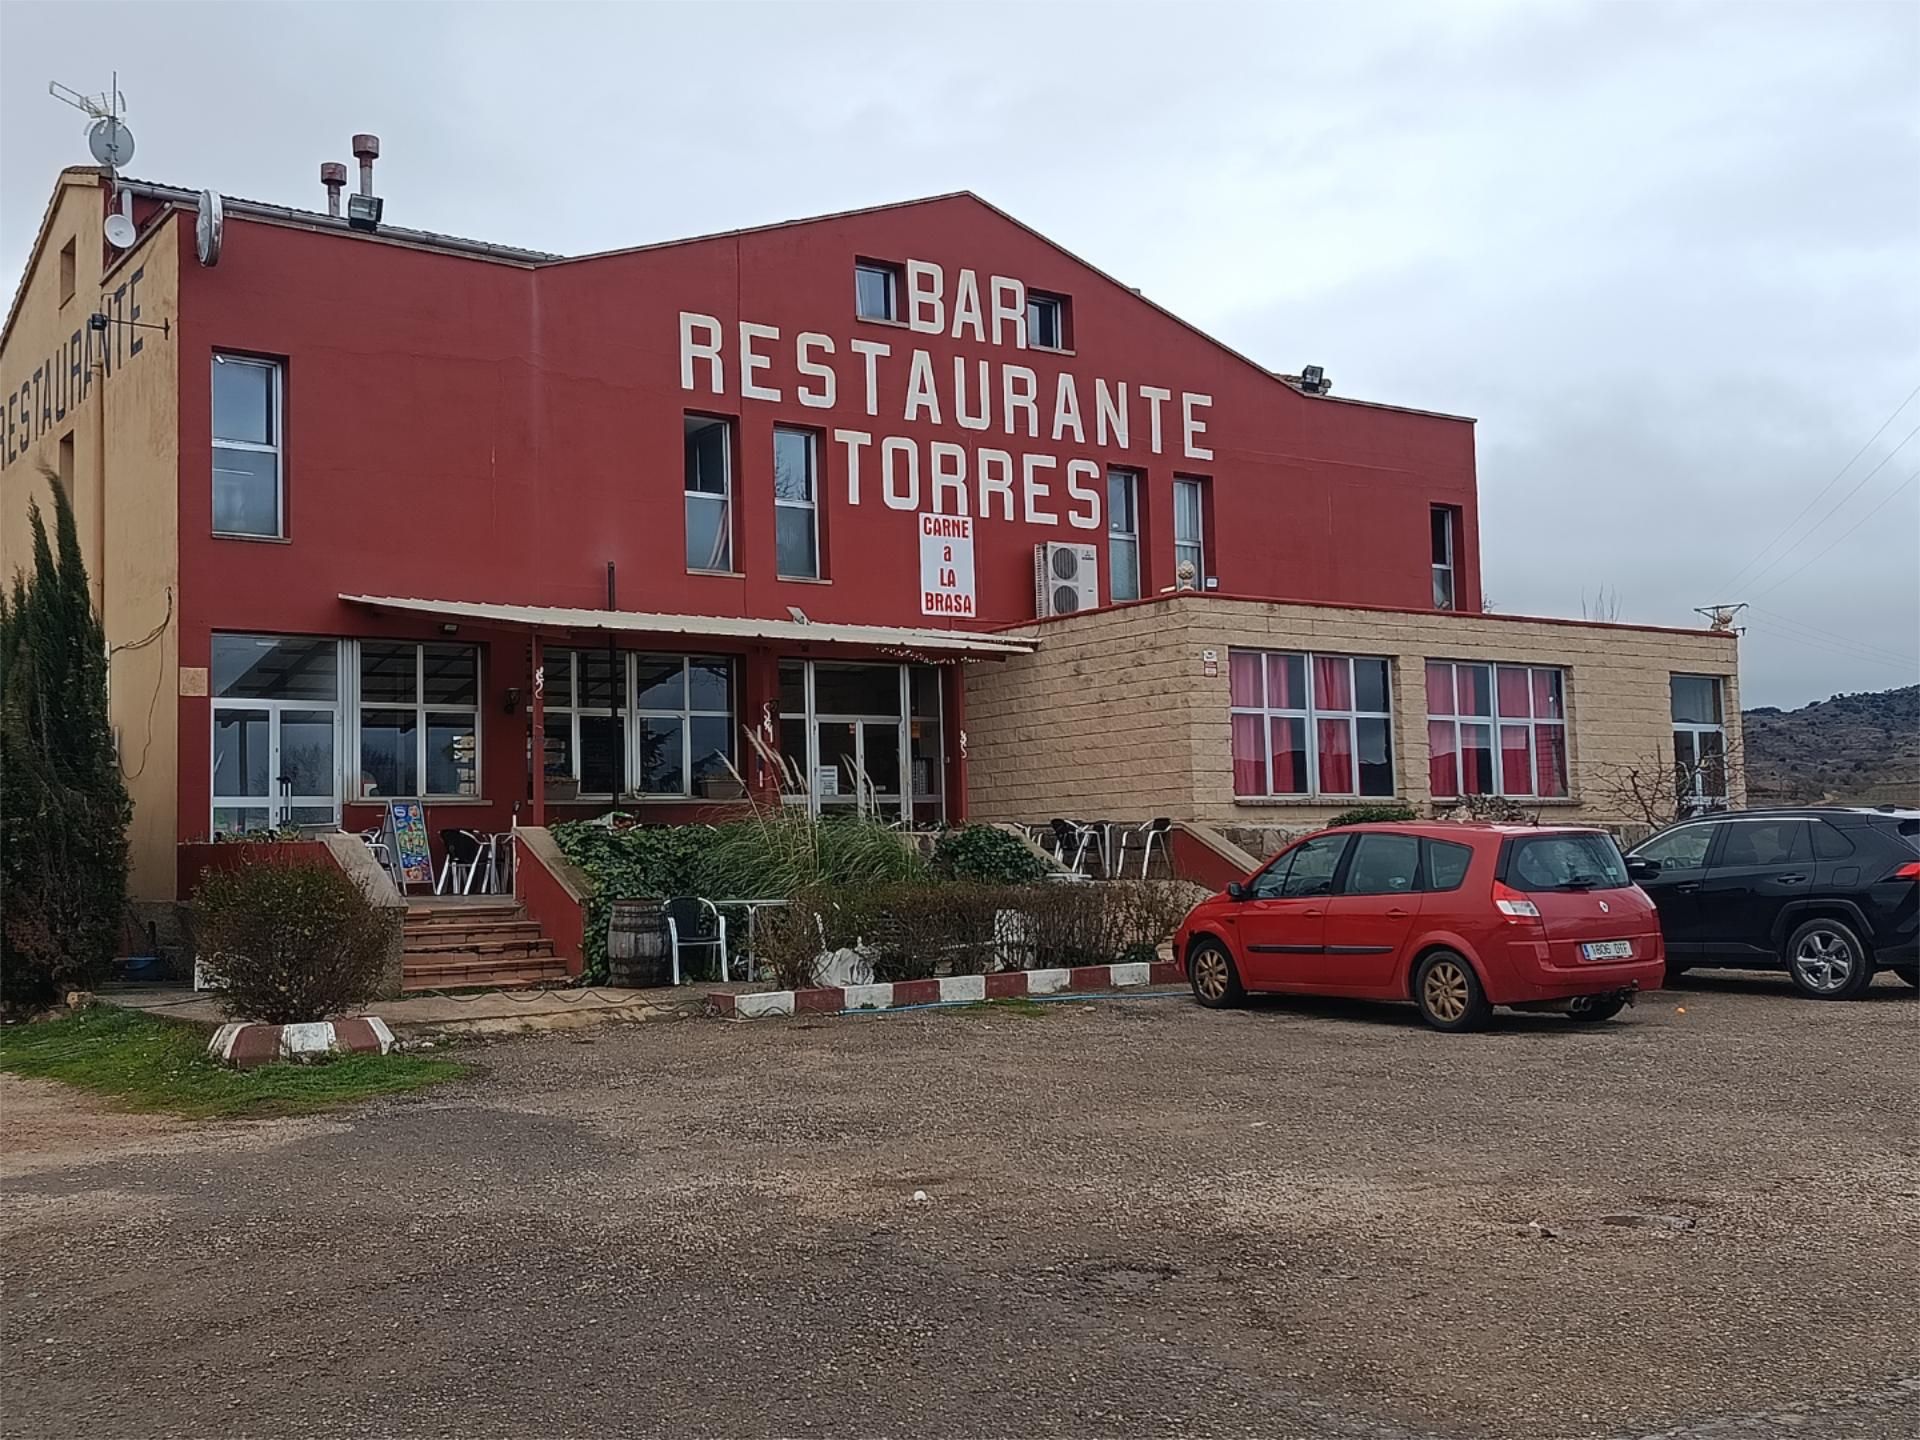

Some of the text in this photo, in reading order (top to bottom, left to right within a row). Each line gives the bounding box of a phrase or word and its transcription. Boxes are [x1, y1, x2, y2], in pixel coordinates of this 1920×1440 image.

[907, 258, 1027, 350] BAR
[679, 311, 1214, 461] RESTAURANTE
[834, 428, 1101, 530] TORRES
[923, 516, 970, 539] CARNE
[943, 545, 952, 562] a
[940, 567, 956, 588] LA
[924, 592, 972, 613] BRASA
